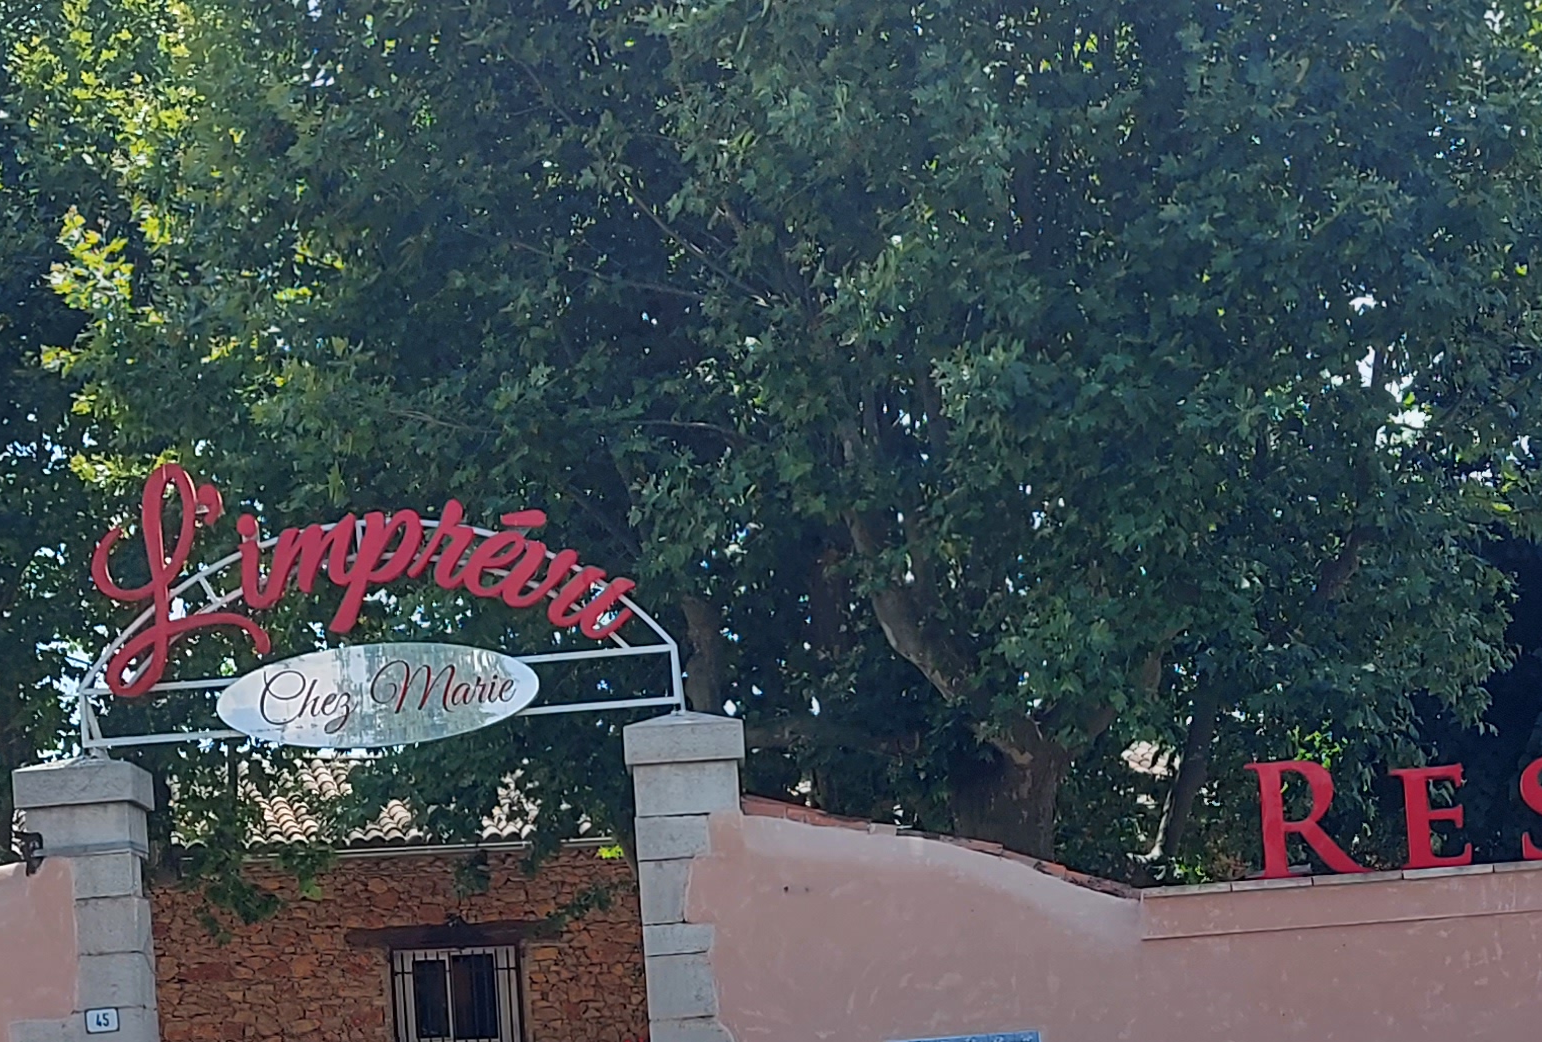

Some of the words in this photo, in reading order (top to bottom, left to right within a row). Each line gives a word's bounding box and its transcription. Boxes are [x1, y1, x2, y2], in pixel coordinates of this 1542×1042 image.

[91, 463, 636, 698] L'imprévu
[259, 669, 359, 735] Chez
[370, 659, 517, 715] Marie
[95, 1012, 110, 1027] 45
